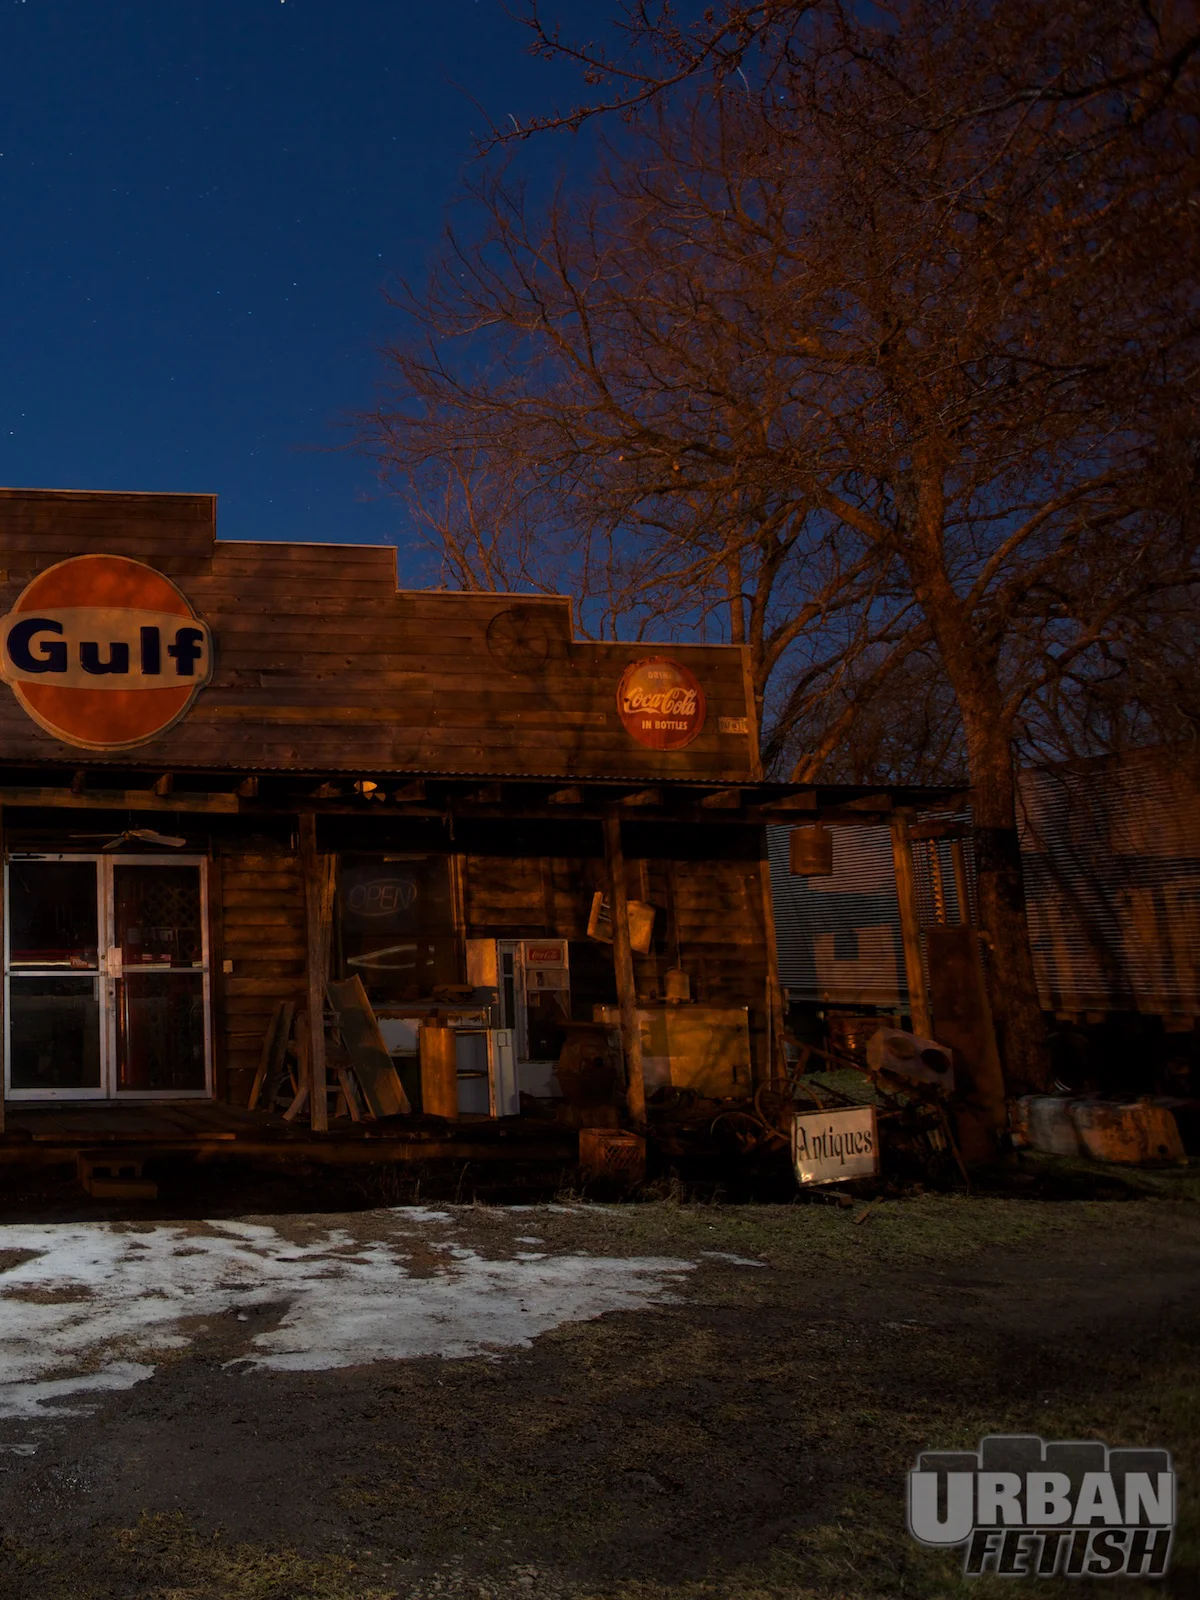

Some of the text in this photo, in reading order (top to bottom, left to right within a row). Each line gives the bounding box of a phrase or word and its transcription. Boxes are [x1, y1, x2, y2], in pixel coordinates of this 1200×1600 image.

[7, 618, 204, 675] Gulf
[623, 687, 697, 716] Coca-Cola
[642, 720, 689, 731] IN BOTTLES
[349, 884, 414, 910] OPEN
[796, 1126, 873, 1165] Antiques
